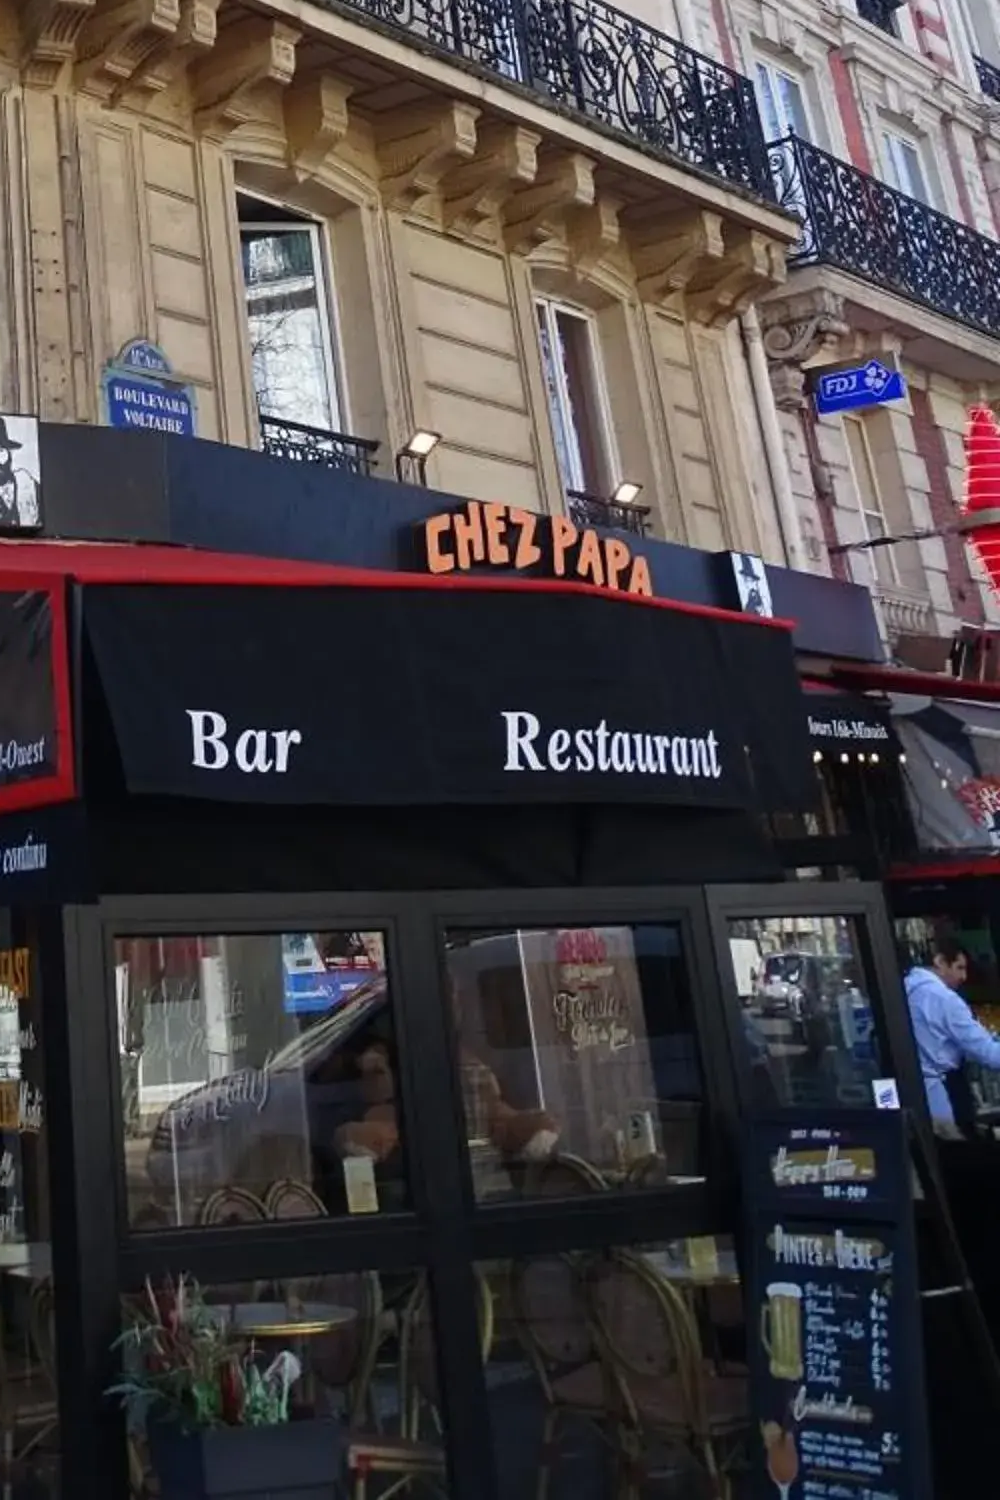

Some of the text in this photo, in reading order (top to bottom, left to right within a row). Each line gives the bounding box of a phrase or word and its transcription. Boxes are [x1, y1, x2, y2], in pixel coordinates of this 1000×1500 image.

[825, 374, 857, 396] FDJ
[114, 386, 189, 415] BOULEVARD
[123, 408, 185, 435] VOLTAIRE
[425, 501, 653, 597] CHEZ PAPA
[186, 709, 722, 779] Bar Restaurant
